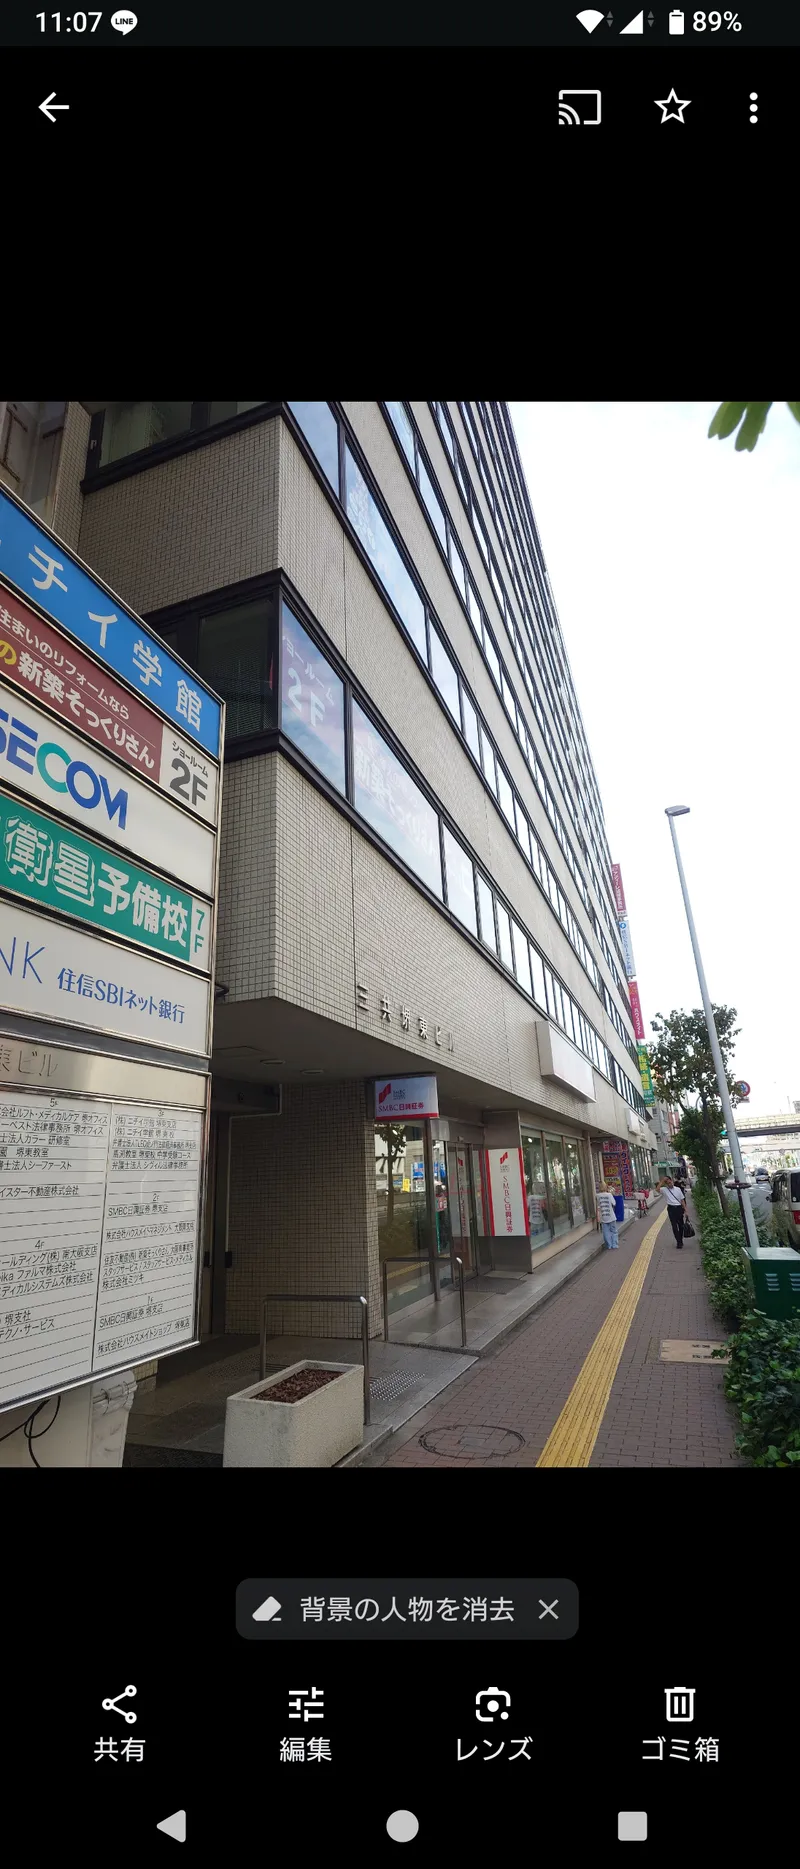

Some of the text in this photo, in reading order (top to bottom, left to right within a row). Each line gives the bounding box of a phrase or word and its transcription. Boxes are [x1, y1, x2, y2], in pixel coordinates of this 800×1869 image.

[282, 636, 334, 706] ョールーム
[288, 668, 325, 727] 2F
[0, 708, 129, 830] ECOM
[169, 757, 208, 806] 2F
[172, 740, 208, 777] ショールーム
[3, 815, 188, 947] 衛星予備校
[194, 908, 206, 954] 7F
[57, 967, 186, 1024] 住信SBIネット銀行
[0, 1106, 80, 1121] 会社ルフト・メディカルケア
